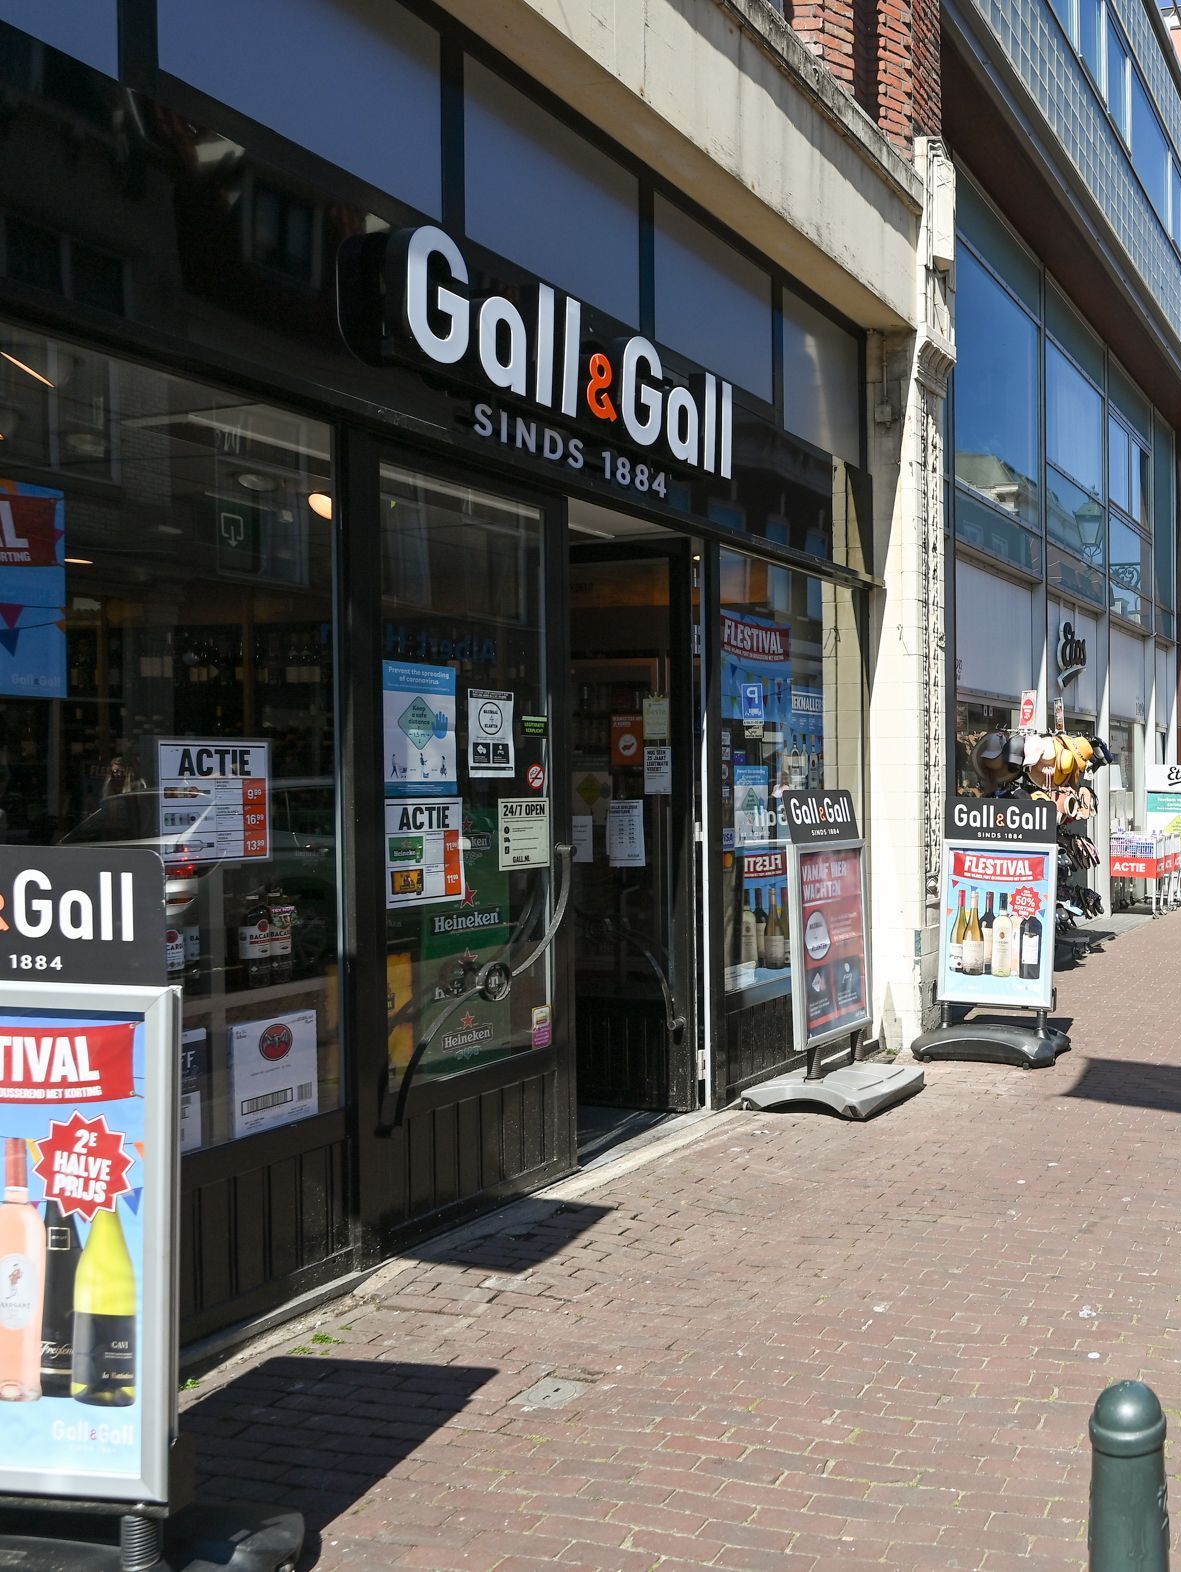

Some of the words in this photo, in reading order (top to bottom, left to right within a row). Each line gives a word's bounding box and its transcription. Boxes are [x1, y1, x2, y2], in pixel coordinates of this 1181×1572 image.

[407, 225, 733, 480] Gall&Gall
[474, 403, 585, 470] SINDS
[601, 450, 668, 499] 1884
[0, 500, 29, 548] L
[723, 619, 784, 654] FLESTIVAL
[1060, 621, 1087, 668] Etos
[178, 748, 252, 777] ACTIE
[398, 806, 450, 830] ACTIE
[503, 803, 523, 817] 24/7
[524, 803, 545, 816] OPEN
[790, 797, 851, 825] Gall&Gall
[953, 803, 1048, 831] Gall&Gall
[811, 829, 827, 837] SINDS
[977, 831, 1001, 839] SINDS
[801, 862, 830, 882] VANAF
[830, 860, 848, 878] HIER
[963, 855, 1033, 876] FLESTIVAL
[1113, 861, 1146, 873] ACTIE
[802, 879, 841, 901] WACHTEN
[1015, 895, 1036, 908] 50%
[433, 911, 500, 934] Heineken
[8, 954, 63, 971] 1884
[443, 1029, 491, 1049] Heineken
[64, 1085, 103, 1099] KORTING
[72, 1128, 98, 1155] 2E
[52, 1150, 113, 1181] HALVE
[52, 1172, 108, 1204] PRIJS
[51, 1419, 135, 1446] Gall&Gall
